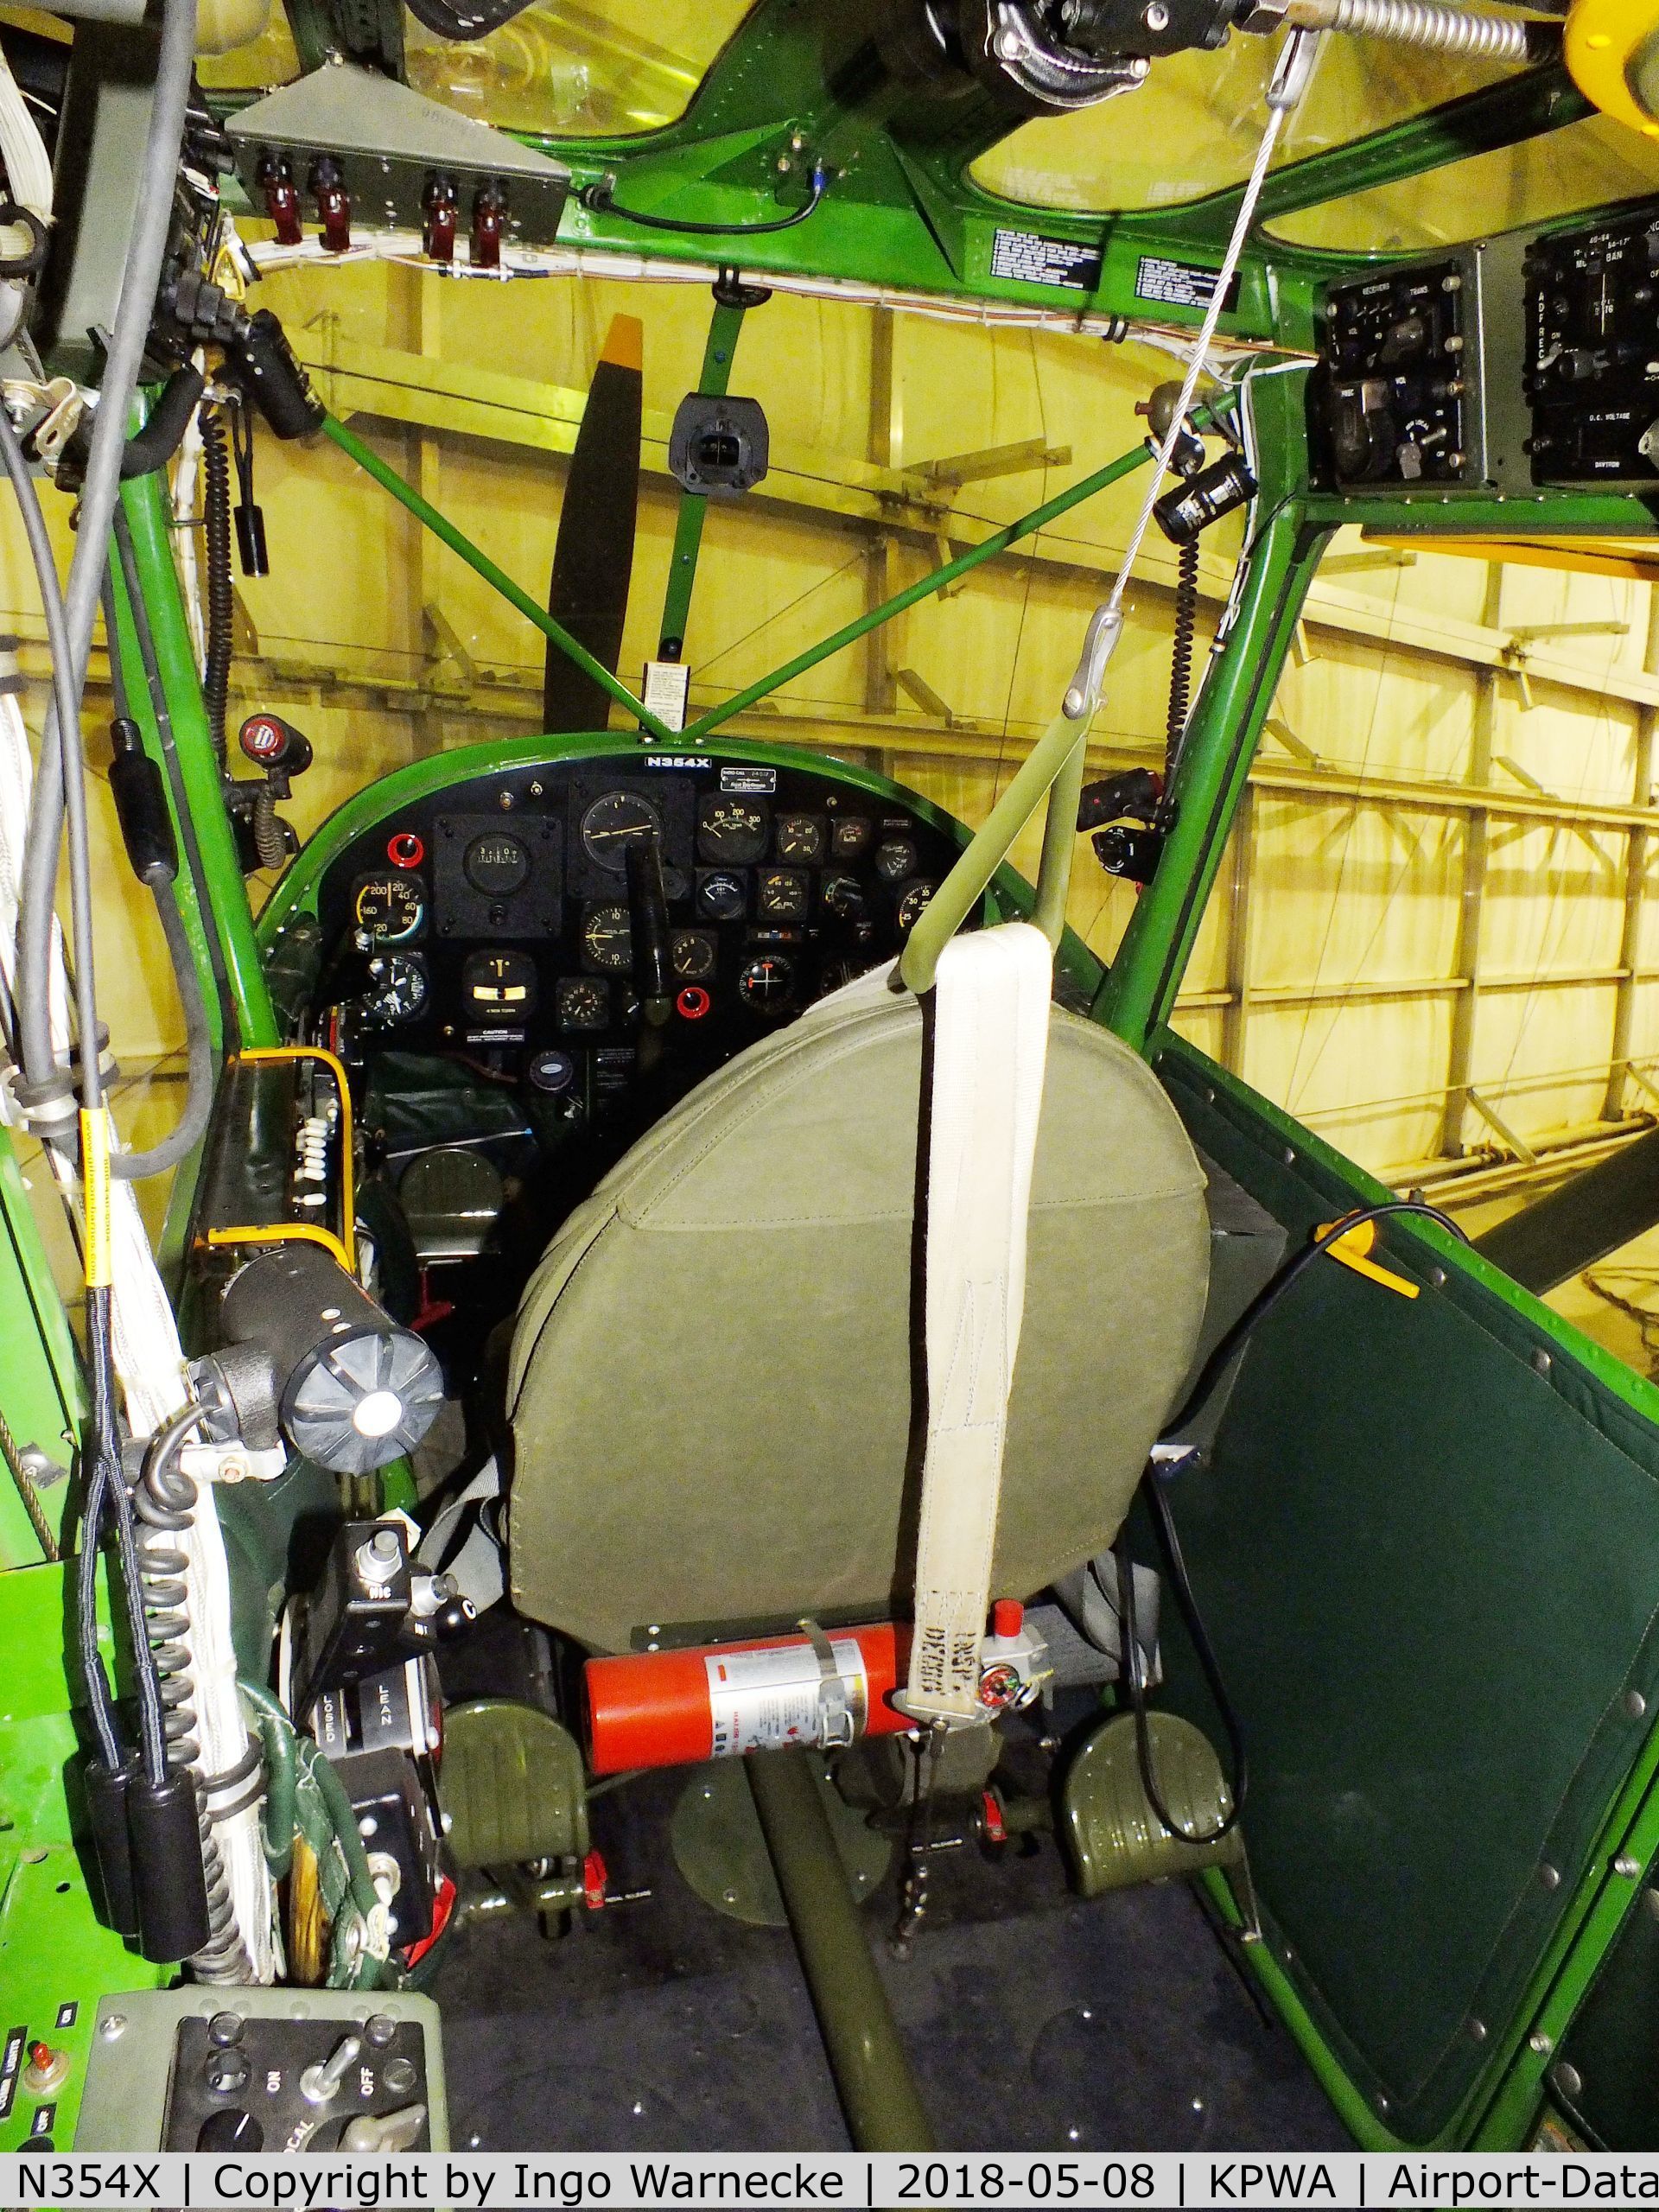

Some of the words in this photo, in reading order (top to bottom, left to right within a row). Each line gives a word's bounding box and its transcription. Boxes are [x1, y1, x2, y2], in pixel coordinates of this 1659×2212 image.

[392, 883, 404, 892] 20
[369, 1586, 391, 1599] MIC
[379, 1685, 392, 1726] LEAN
[5, 2038, 22, 2073] LIGHTS
[266, 2070, 281, 2092] ON
[360, 2067, 374, 2096] OFF
